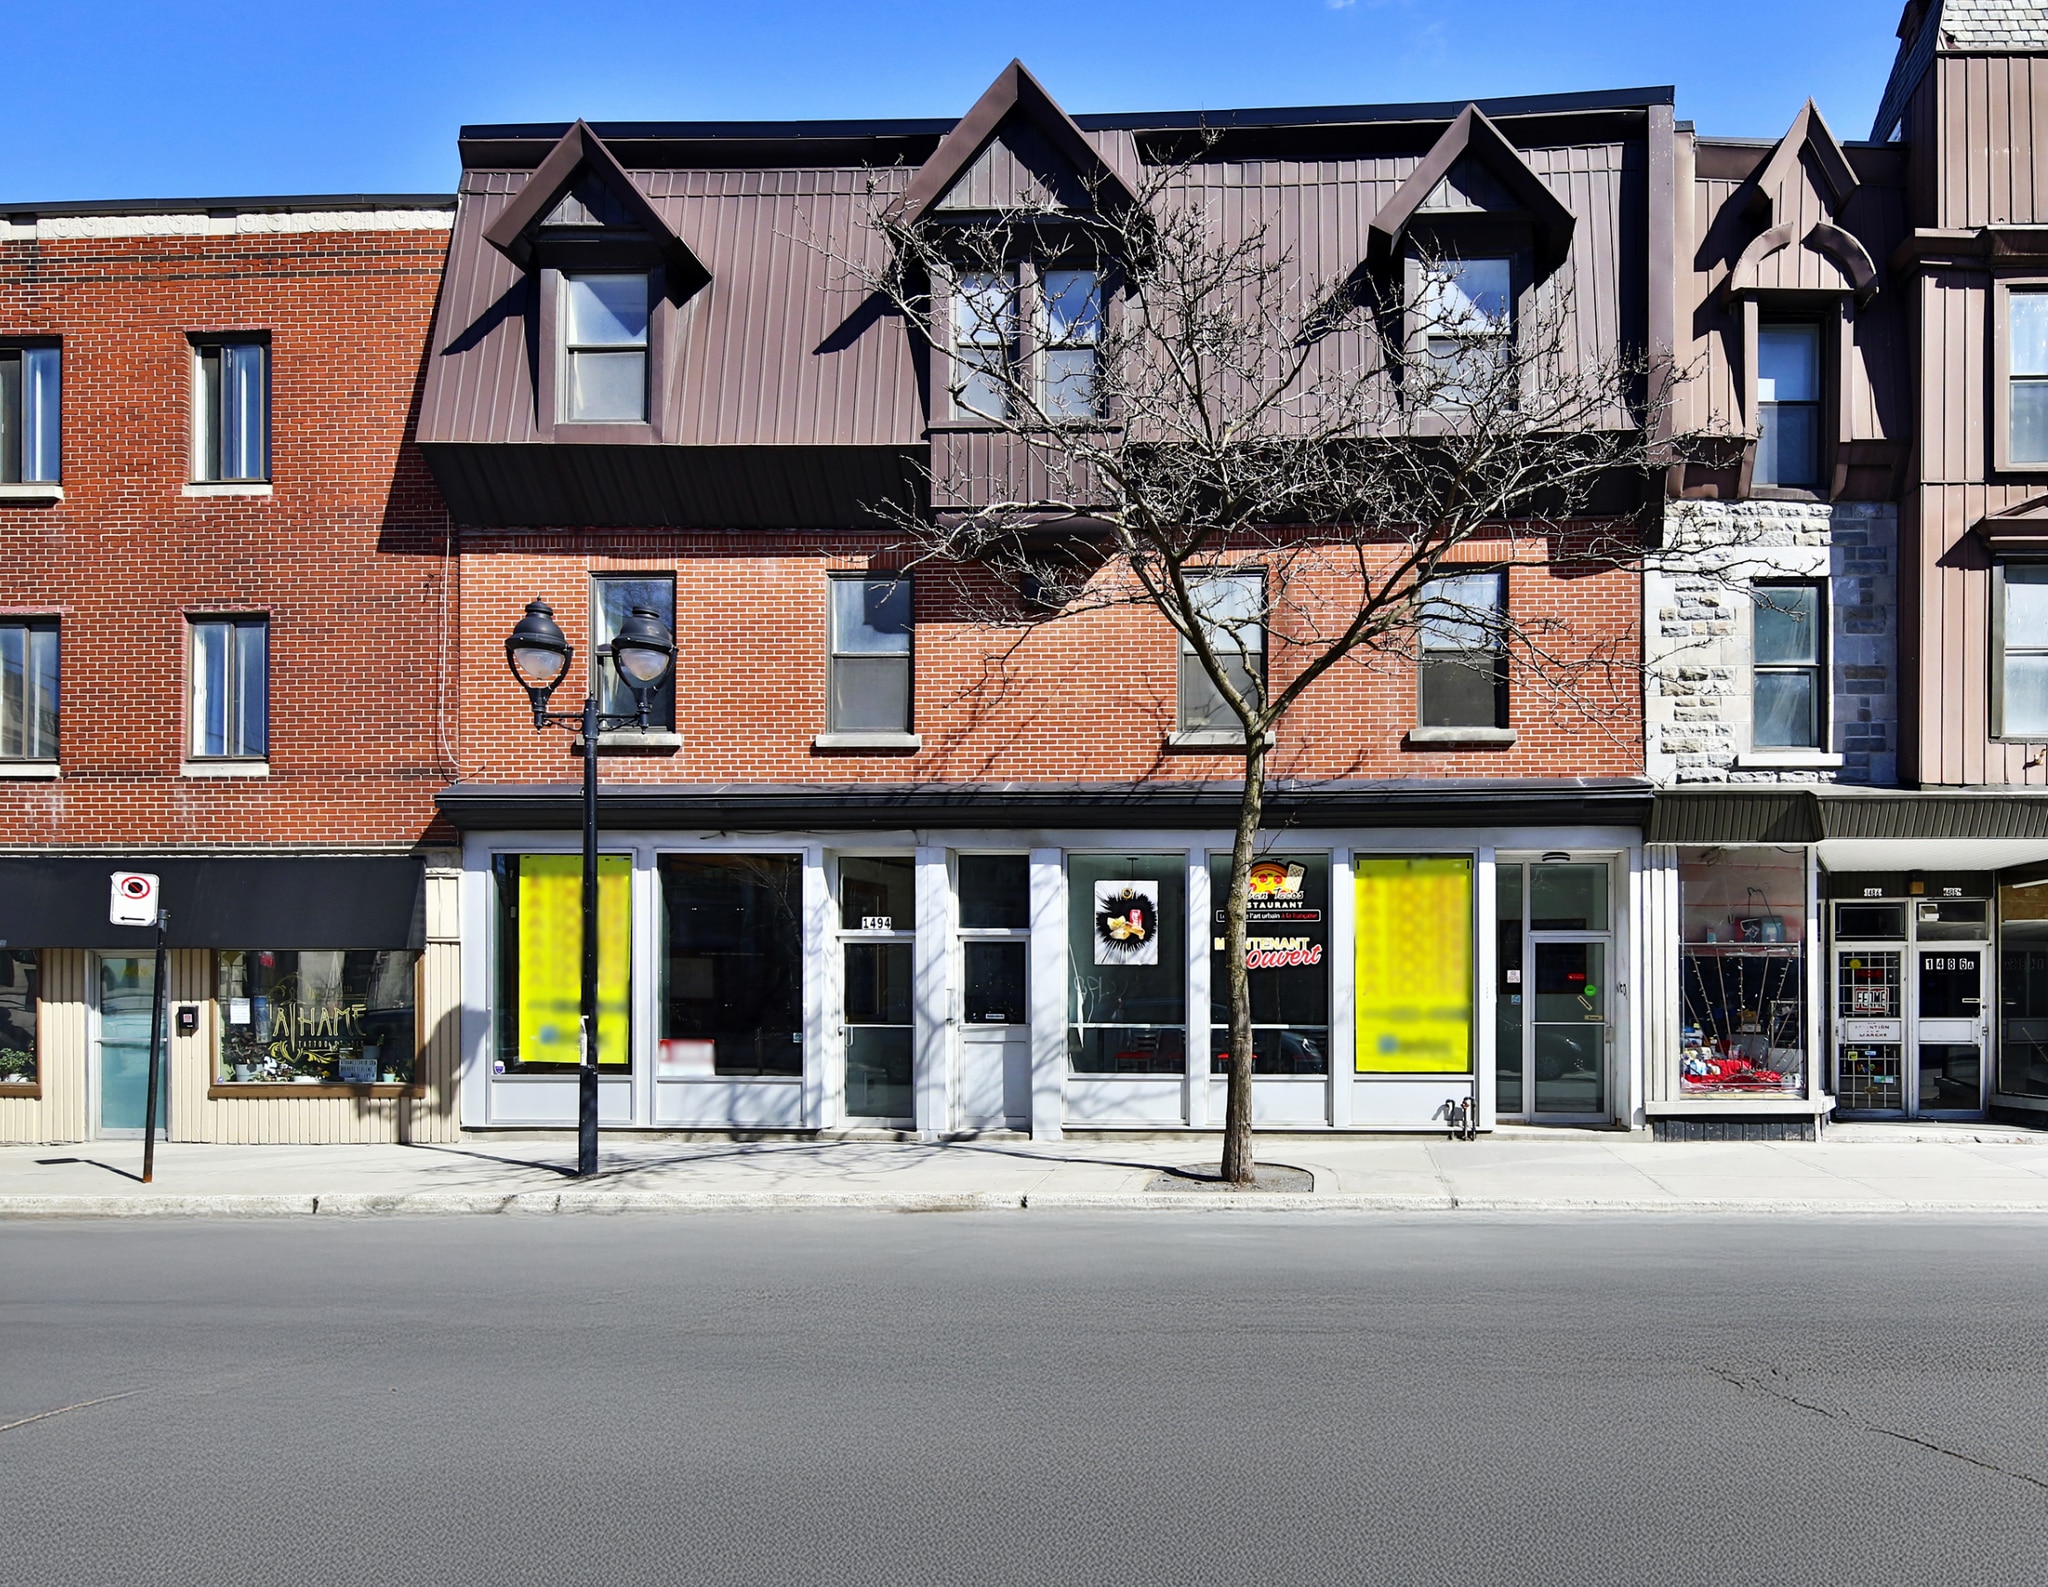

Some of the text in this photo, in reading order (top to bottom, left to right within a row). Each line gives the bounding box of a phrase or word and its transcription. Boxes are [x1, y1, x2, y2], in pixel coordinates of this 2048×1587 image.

[1247, 889, 1268, 900] ban
[863, 917, 891, 929] 1494
[1246, 944, 1323, 969] Ouvert
